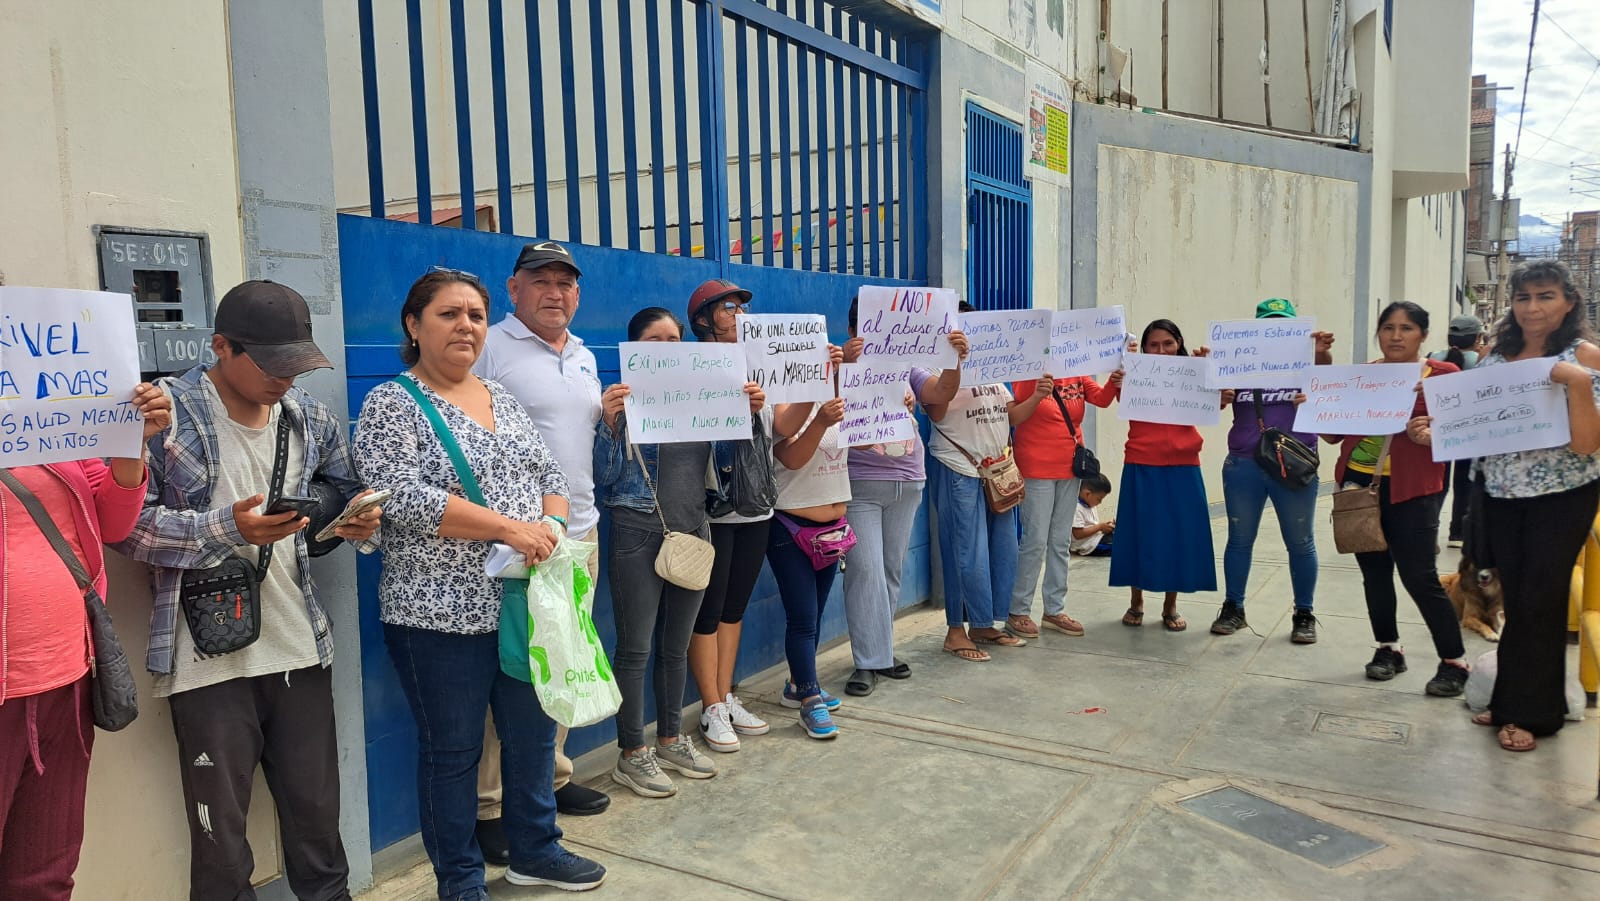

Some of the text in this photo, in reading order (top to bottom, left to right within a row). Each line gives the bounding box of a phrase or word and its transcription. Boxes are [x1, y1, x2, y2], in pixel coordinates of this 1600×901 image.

[890, 288, 933, 316] ¡NO!
[862, 310, 953, 335] al abuso de
[963, 319, 1001, 336] Somos
[1051, 320, 1082, 338] UGEL
[743, 321, 763, 342] POR
[767, 322, 785, 337] UNA
[863, 333, 940, 357] autoridad
[1016, 337, 1025, 352] y
[1213, 346, 1258, 359] en paz
[768, 369, 777, 387] A
[782, 360, 831, 386] MARIBEL!
[1130, 360, 1141, 373] X
[36, 369, 109, 400] MAS
[871, 396, 885, 409] NO
[1236, 389, 1298, 402] Garrid
[1, 401, 141, 435] SALUD MENTAL
[725, 415, 746, 428] MAS
[876, 426, 895, 440] MAS
